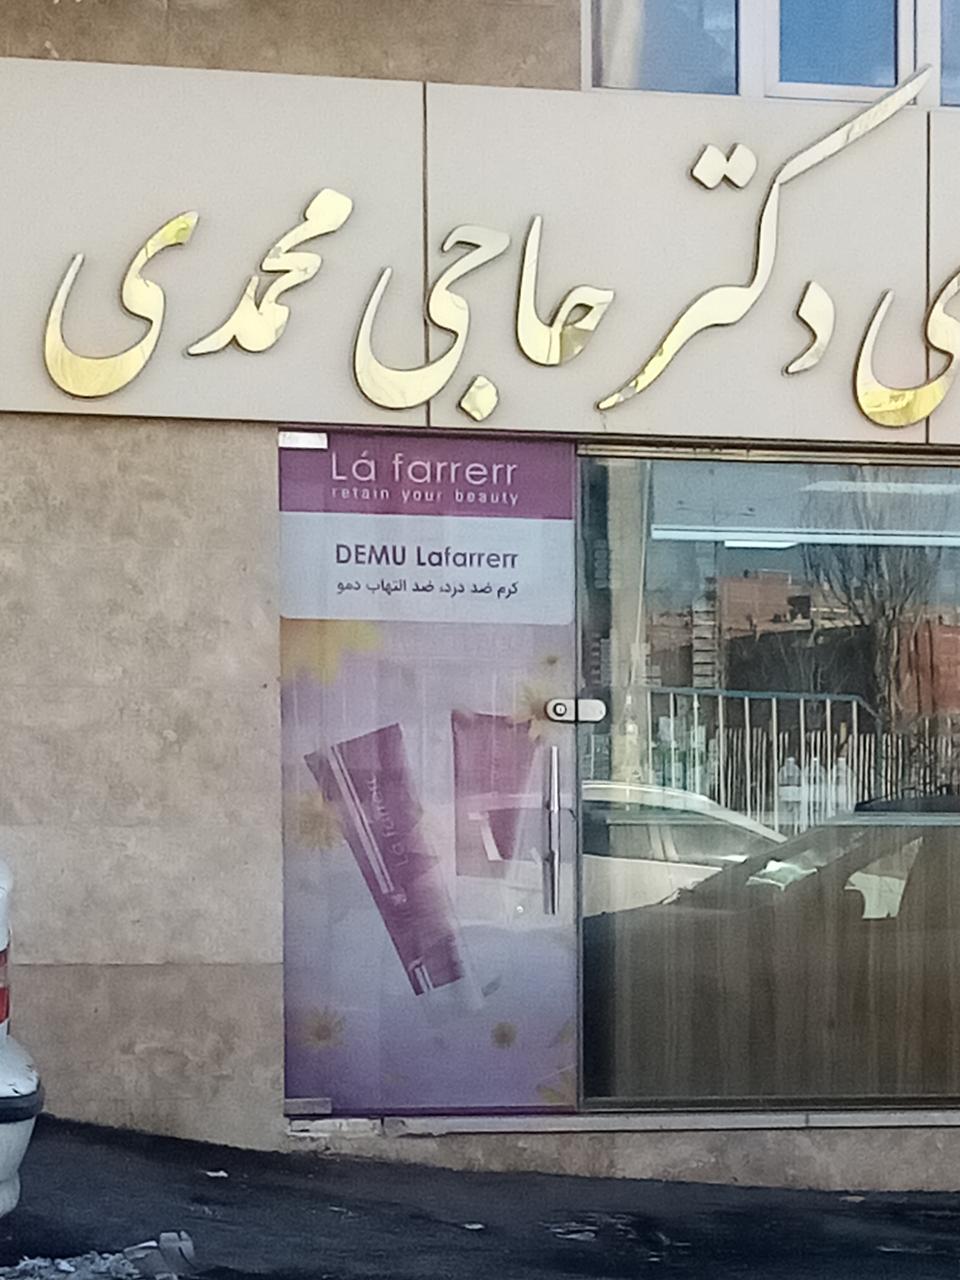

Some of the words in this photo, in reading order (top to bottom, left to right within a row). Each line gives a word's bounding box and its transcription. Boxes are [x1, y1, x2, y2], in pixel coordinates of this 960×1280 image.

[596, 64, 933, 411] دکتر
[43, 187, 354, 399] محمدی
[353, 215, 615, 422] حاجی
[332, 450, 376, 482] Lá
[392, 452, 518, 485] farrerr
[331, 486, 390, 500] retain
[401, 488, 443, 504] your
[455, 489, 519, 507] beauty
[335, 544, 406, 566] DEMU
[416, 546, 519, 569] Lafarrerr
[336, 580, 361, 595] دمو
[365, 578, 407, 596] التهاب
[411, 580, 435, 593] ضد
[470, 582, 493, 595] ضد
[496, 581, 519, 599] کرم
